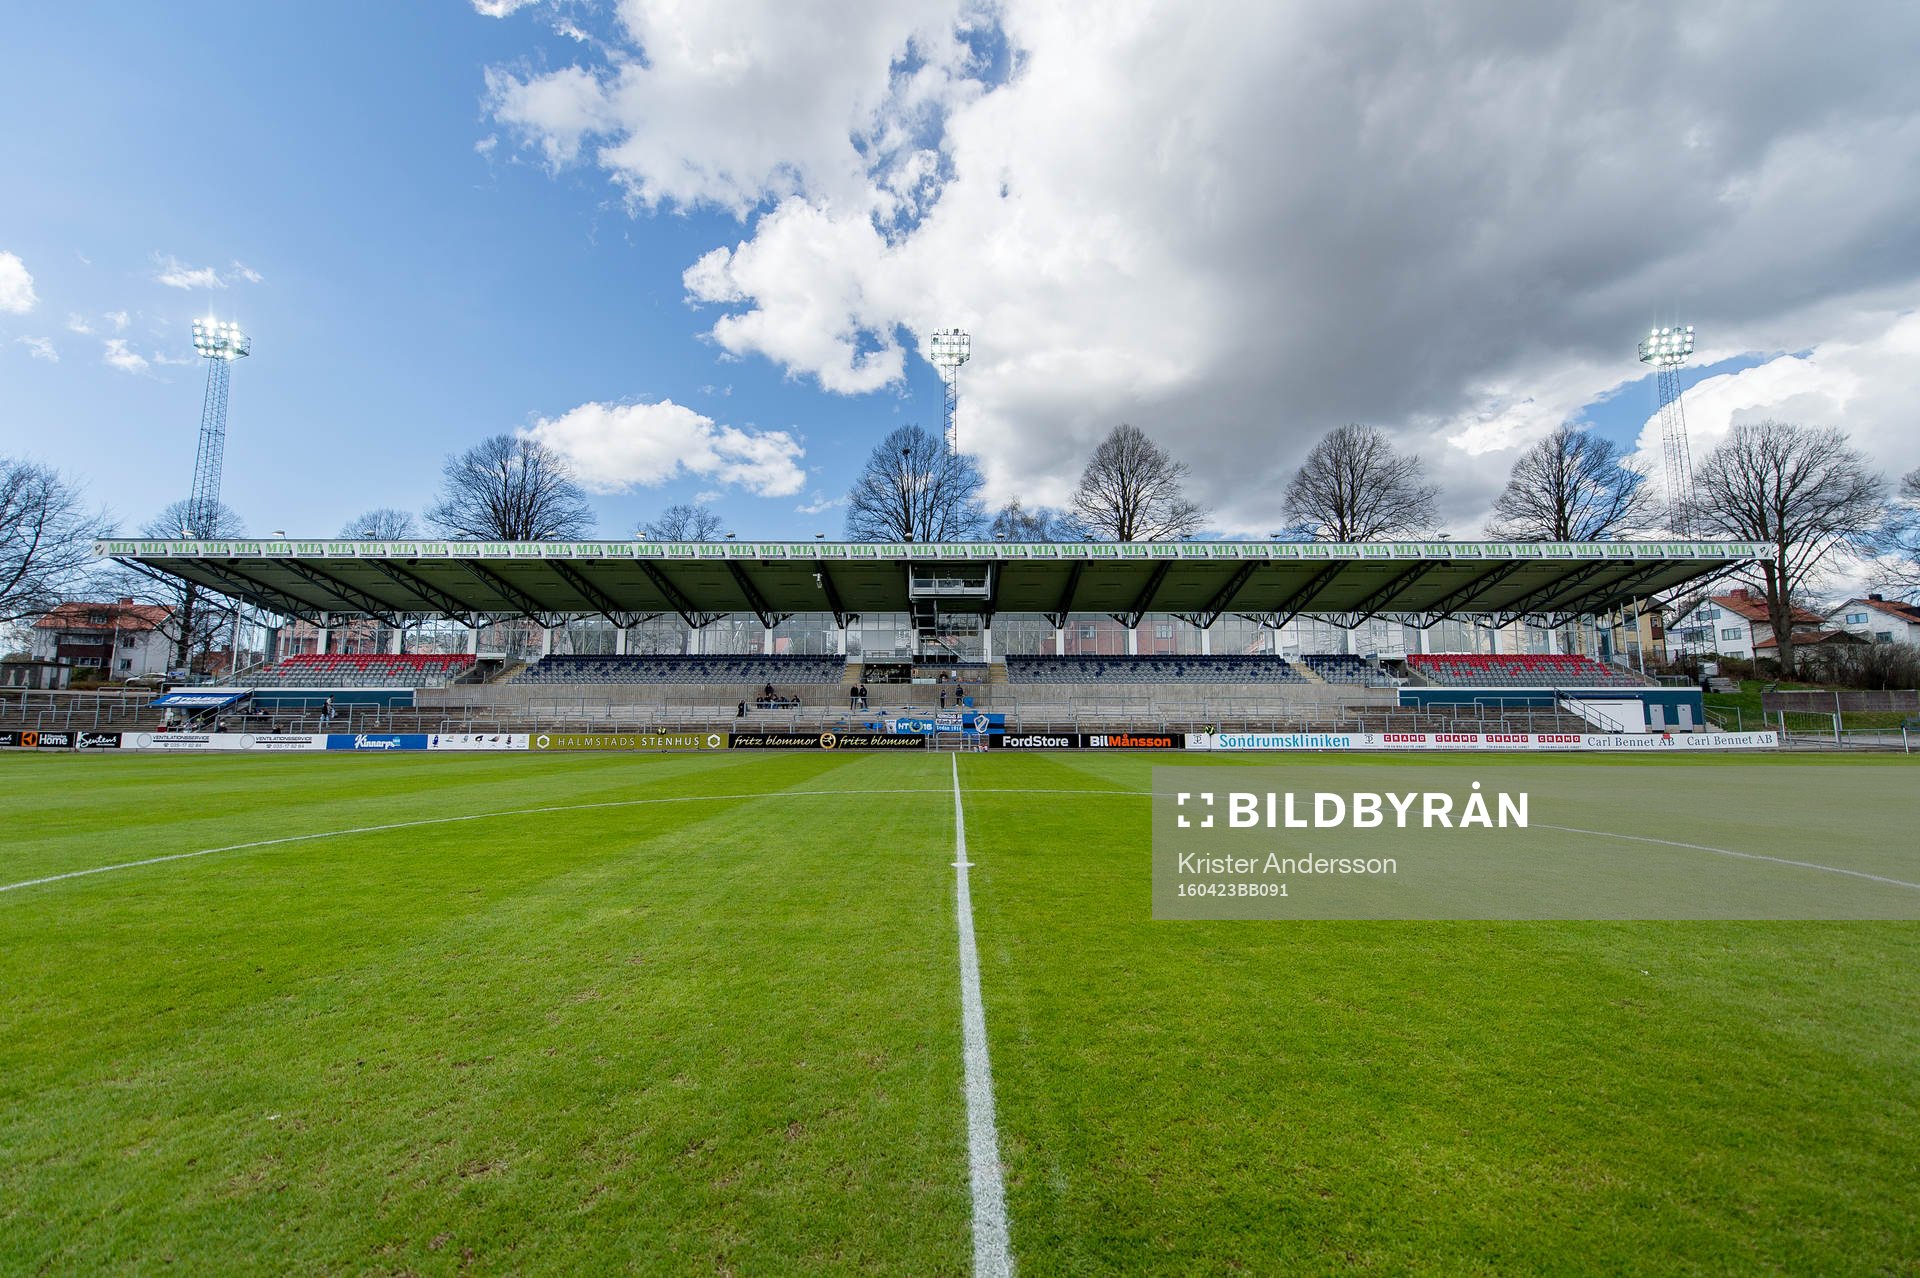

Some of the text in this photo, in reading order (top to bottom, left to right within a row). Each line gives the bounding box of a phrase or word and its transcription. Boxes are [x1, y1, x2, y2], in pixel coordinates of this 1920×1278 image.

[109, 543, 1756, 555] MTA MTA MTA MTA MTA MTA MTA MTA MTA MTA MTA MTA MTA MTA MTA MTA MTA MTA MTA MTA MTA MTA MTA MTA MTA MTA MTA MTA MTA MTA MTA MTA MTA MTA MTA MTA MTA MTA MTA MTA MTA MTA MTA MTA MTA MTA MTA MTA MTA MTA MTA MTA MTA MTA
[39, 733, 68, 745] Home
[557, 737, 699, 746] HALMSTADS STENHUS
[731, 735, 818, 750] fritz blommor
[838, 735, 922, 750] fritz blommor
[1002, 735, 1069, 747] FordStore
[1089, 733, 1171, 747] BilMånsson
[1587, 737, 1610, 747] Carl
[1615, 737, 1654, 747] Bennet
[1687, 734, 1773, 747] Carl Bennet AB
